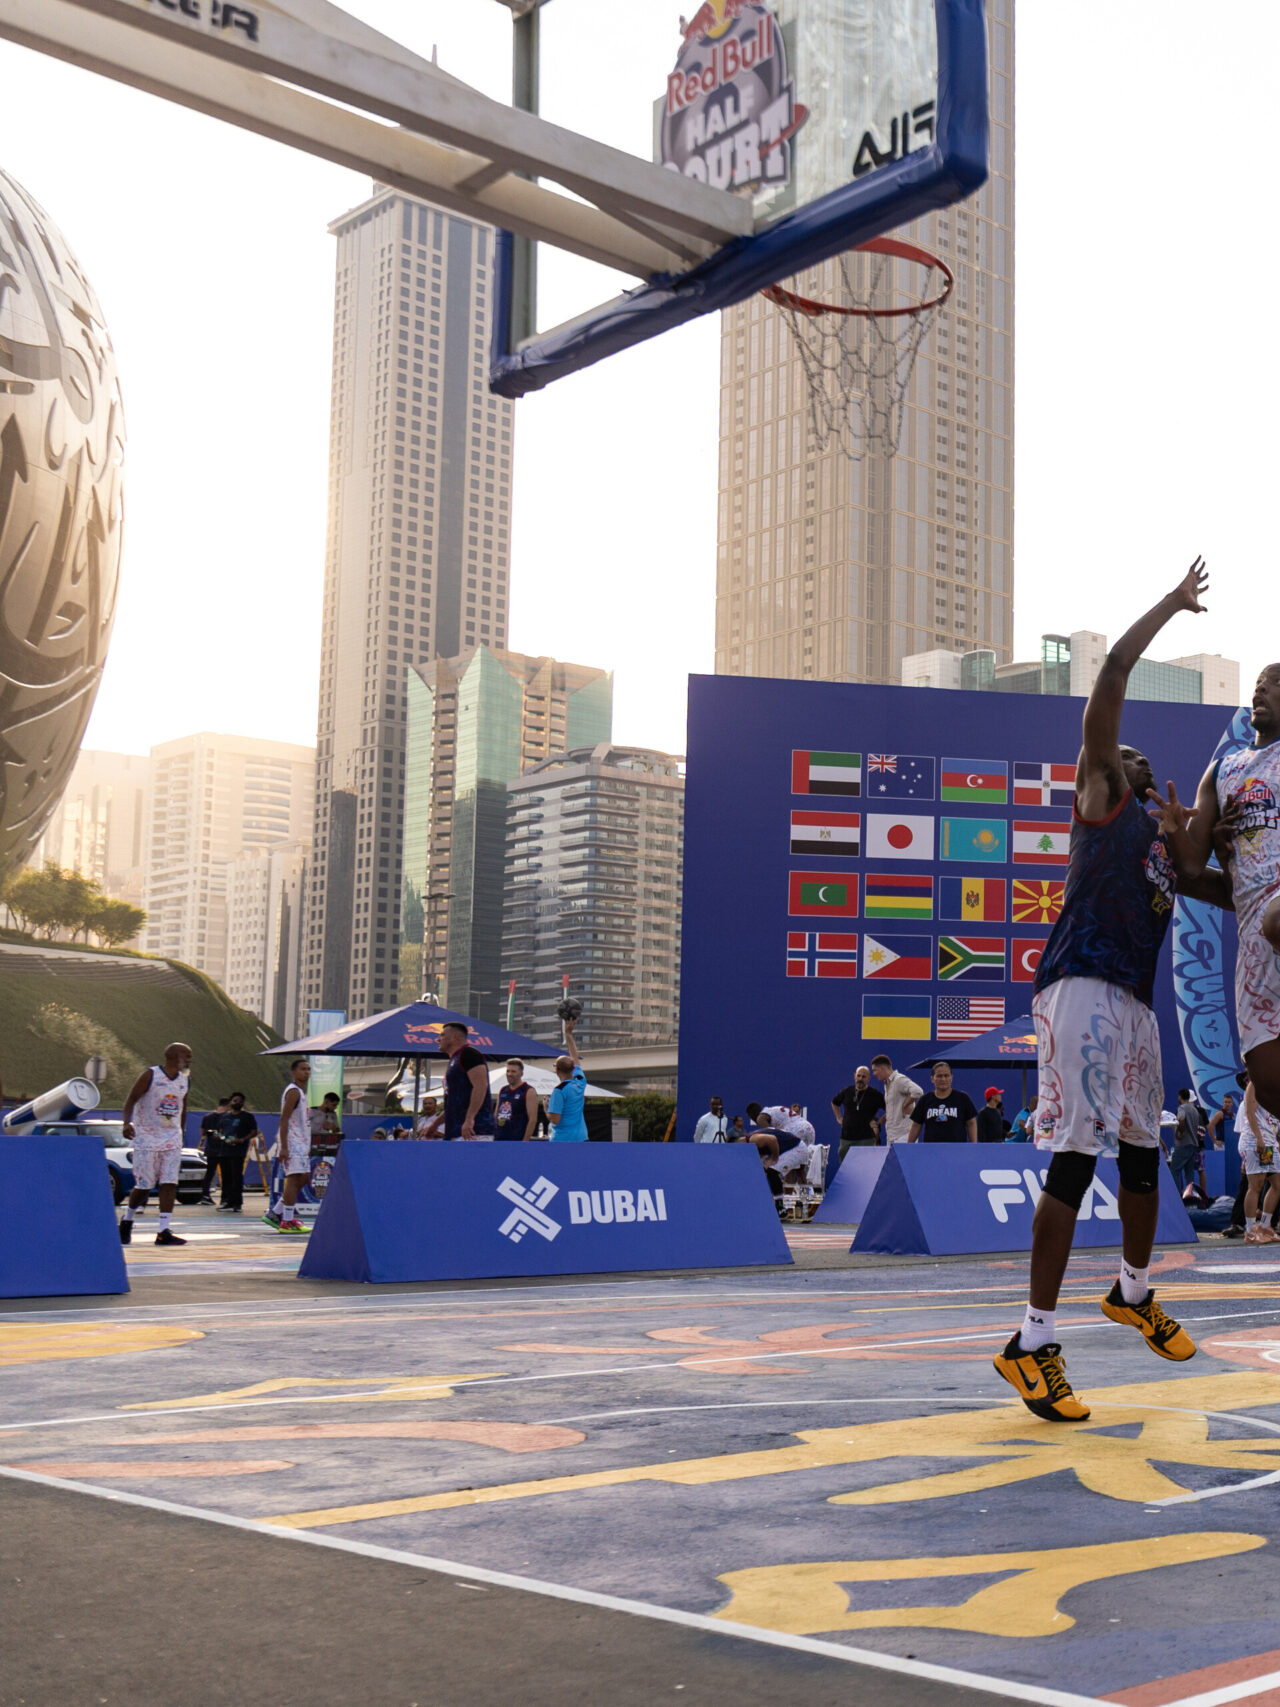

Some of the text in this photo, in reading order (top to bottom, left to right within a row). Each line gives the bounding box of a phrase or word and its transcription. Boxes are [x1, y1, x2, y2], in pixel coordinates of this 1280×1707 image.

[667, 14, 773, 114] Red Bull
[662, 91, 790, 191] OURT
[686, 84, 755, 152] HALF
[998, 1045, 1036, 1054] Red
[927, 1107, 957, 1119] DREAM
[568, 1189, 667, 1224] DUBAI
